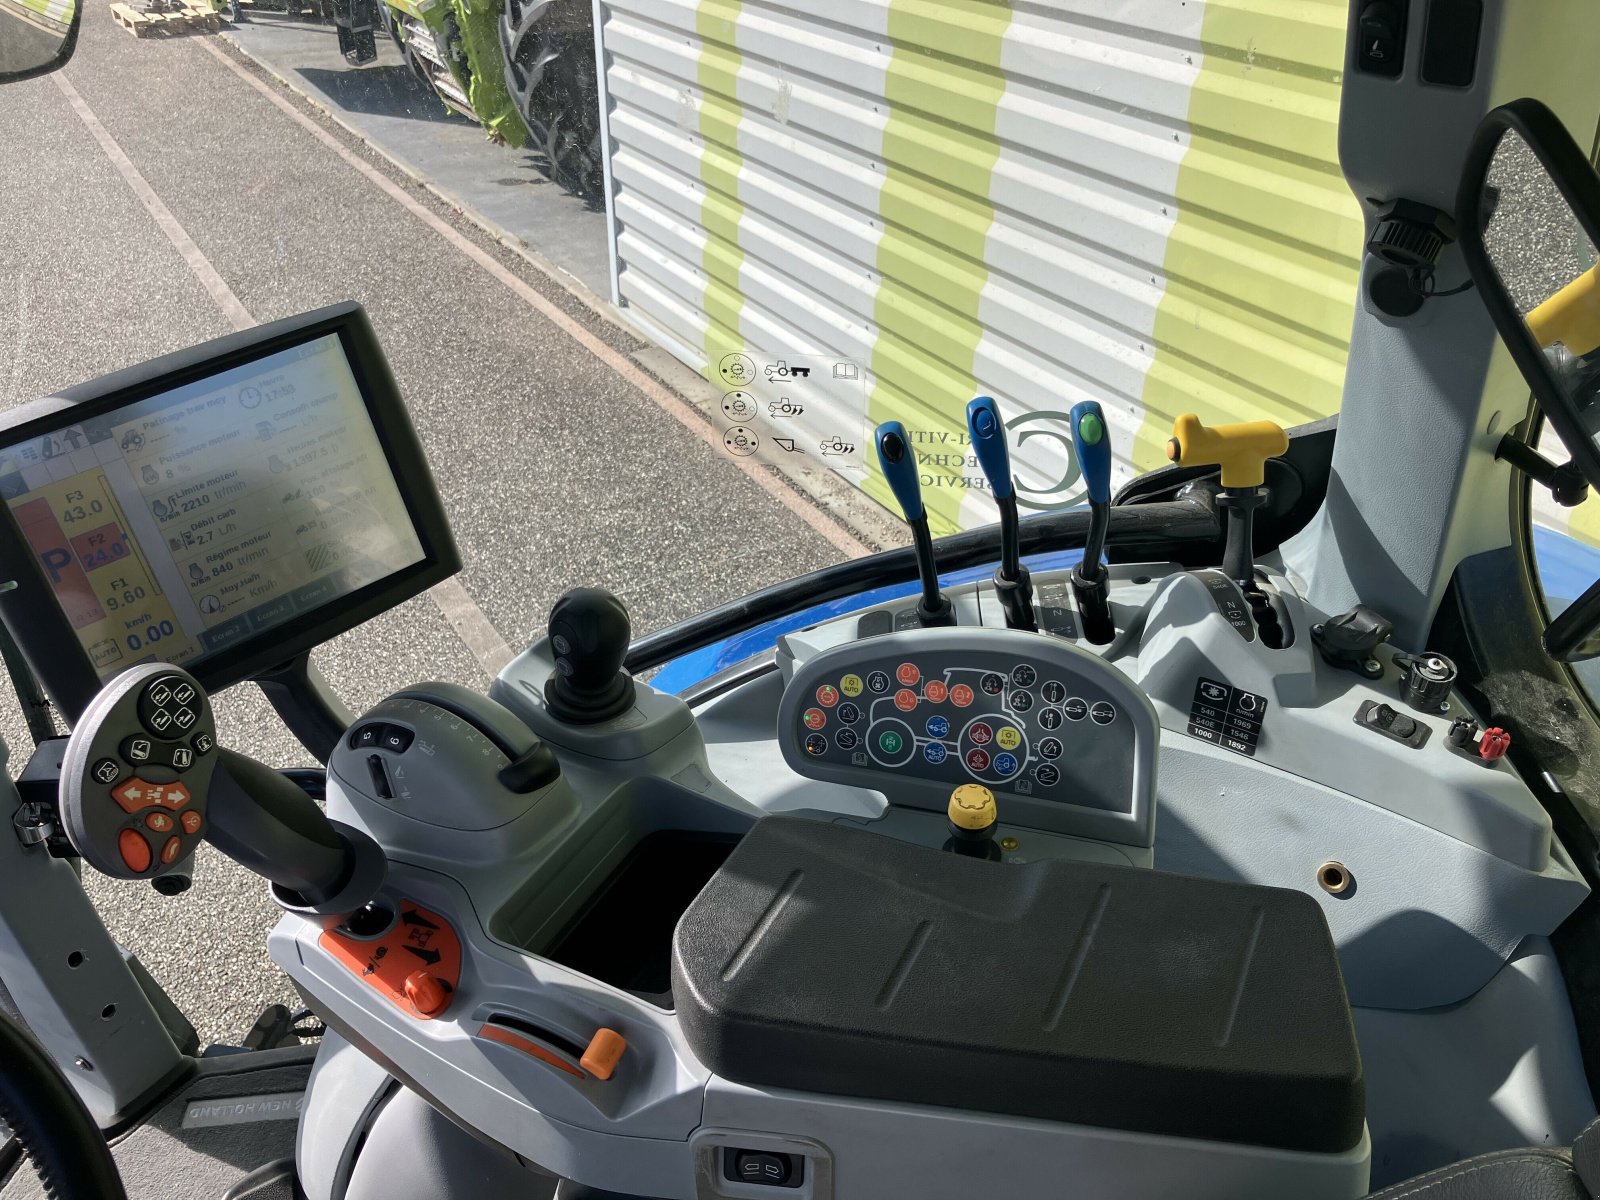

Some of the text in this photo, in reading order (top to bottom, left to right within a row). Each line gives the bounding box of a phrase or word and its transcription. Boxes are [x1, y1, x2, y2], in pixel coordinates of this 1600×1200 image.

[174, 469, 239, 499] Limite moteur
[181, 480, 247, 512] 2210 tr/min
[65, 490, 84, 503] F3
[63, 499, 103, 523] 43.0
[190, 508, 237, 532] Débit carb
[88, 533, 105, 547] F2
[196, 531, 214, 545] 2.7
[206, 531, 272, 563] Régime moteur
[41, 547, 71, 584] P
[84, 543, 124, 568] 24.0
[212, 546, 270, 577] 840 tr/min
[110, 578, 129, 591] F1
[106, 586, 146, 610] 9.60
[1226, 601, 1236, 609] N
[125, 613, 152, 629] km/h
[1053, 609, 1062, 617] N
[126, 620, 174, 651] 0.00
[1195, 716, 1249, 740] 540E 1546
[1200, 707, 1252, 730] 540 1969
[1194, 728, 1246, 752] 1000 1892
[189, 1099, 292, 1118] NEW HOLLAND
